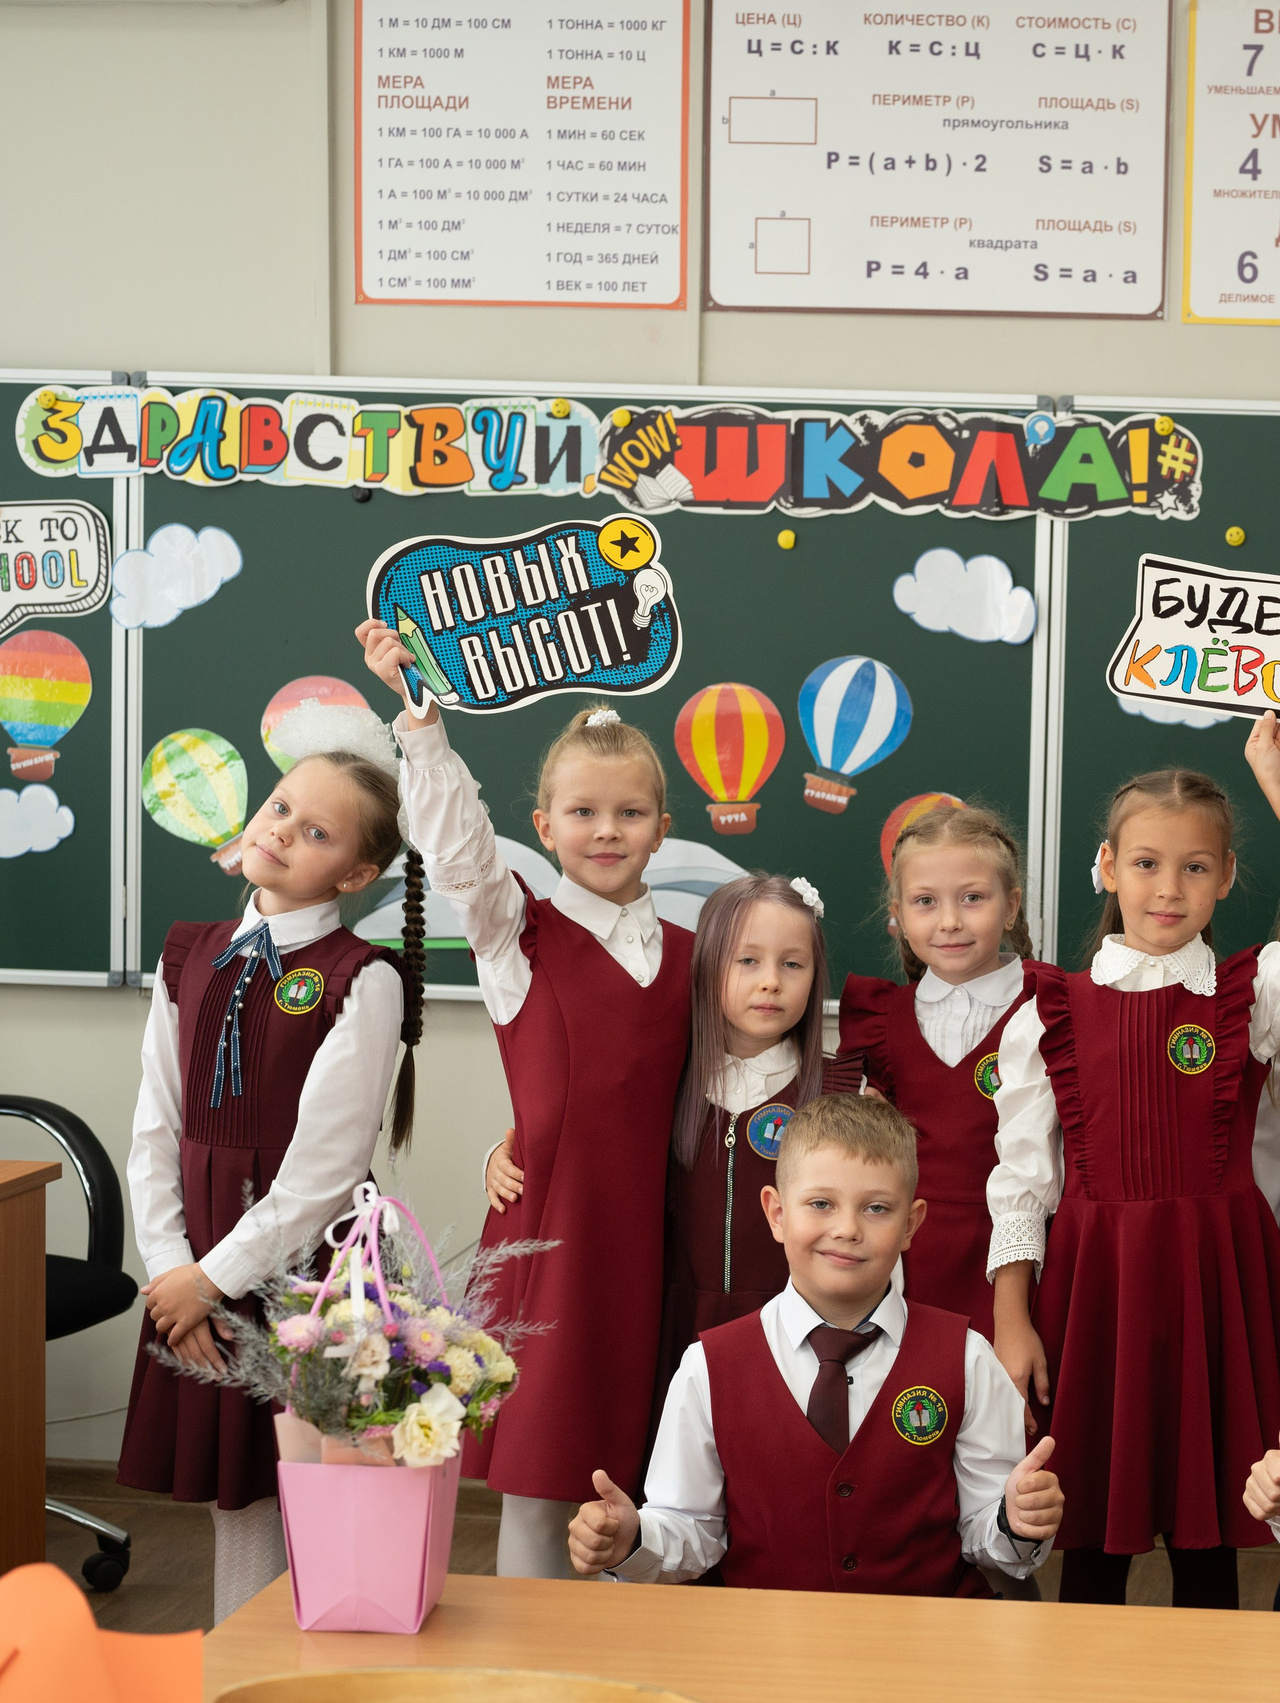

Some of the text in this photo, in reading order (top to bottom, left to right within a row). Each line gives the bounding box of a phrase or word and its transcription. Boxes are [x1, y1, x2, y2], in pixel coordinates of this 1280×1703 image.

[557, 18, 604, 30] ТОННА
[619, 19, 648, 31] 1000
[651, 20, 667, 31] КГ
[735, 12, 778, 27] ЦЕНА
[863, 13, 968, 27] КОЛИЧЕСТВО
[1015, 15, 1112, 30] СТОИМОСТЬ
[557, 48, 604, 61] ТОННА
[618, 49, 633, 61] 10
[636, 50, 647, 63] Ц
[747, 38, 763, 58] Ц
[789, 39, 805, 55] С
[825, 40, 840, 56] К
[1242, 44, 1264, 76] 7
[377, 74, 425, 90] МЕРА
[546, 75, 595, 90] МЕРА
[377, 94, 470, 112] ПЛОЩАДИ
[546, 95, 632, 111] ВРЕМЕНИ
[871, 93, 952, 107] ПЕРИМЕТР
[1038, 96, 1117, 112] ПЛОЩАДЬ
[942, 118, 1069, 132] прямоугольника
[556, 128, 586, 140] МИН
[600, 129, 616, 141] 60
[619, 129, 646, 141] СЕК
[1238, 148, 1262, 181] 4
[870, 215, 950, 229] ПЕРИМЕТР
[1035, 218, 1114, 234] ПЛОЩАДЬ
[968, 238, 1038, 252] квадрата
[1237, 251, 1259, 283] 6
[1218, 292, 1275, 304] ДЕЛИМОЕ
[600, 410, 683, 490] WOW!
[40, 516, 79, 543] TO
[419, 535, 590, 632] НОВЫХ
[459, 598, 632, 700] ВЫСОТ!
[280, 971, 314, 989] ГИМНАЗИЯ
[977, 1055, 999, 1081] ГИМНАЗИ
[895, 1389, 945, 1418] ГИМНАЗИЯ № 16
[912, 1430, 940, 1442] Тюмень
